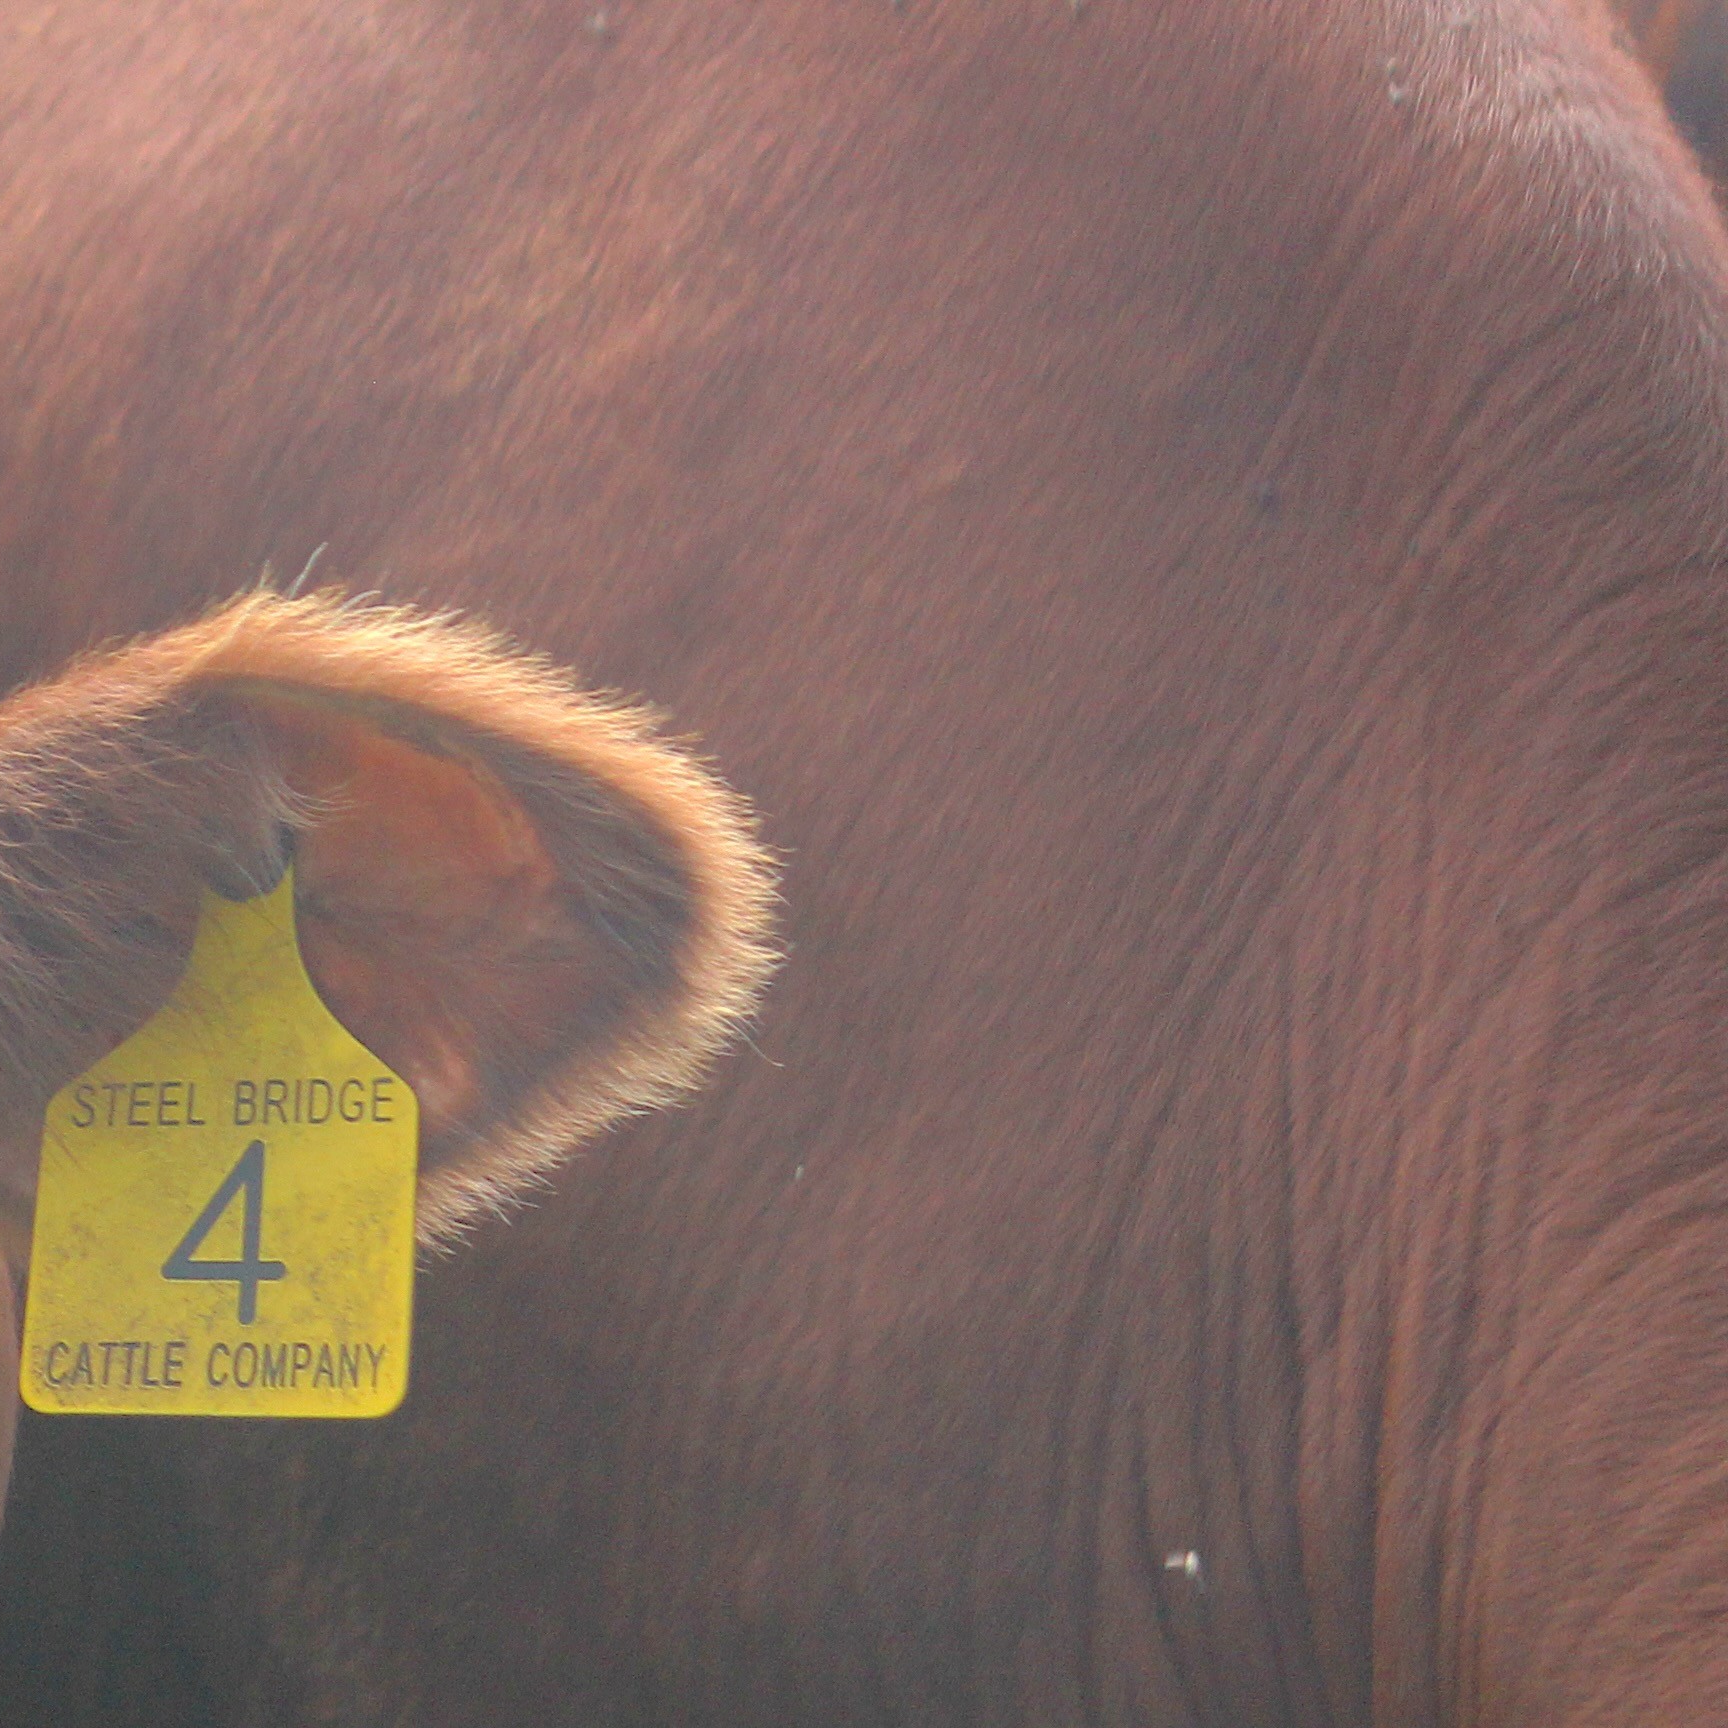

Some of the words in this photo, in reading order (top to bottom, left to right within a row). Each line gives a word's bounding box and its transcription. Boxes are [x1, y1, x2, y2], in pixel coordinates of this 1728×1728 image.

[71, 1082, 205, 1128] STEEL
[233, 1077, 395, 1126] BRIDGE
[161, 1139, 287, 1326] 4
[45, 1341, 187, 1388] CATTLE
[207, 1342, 386, 1390] COMPANY
